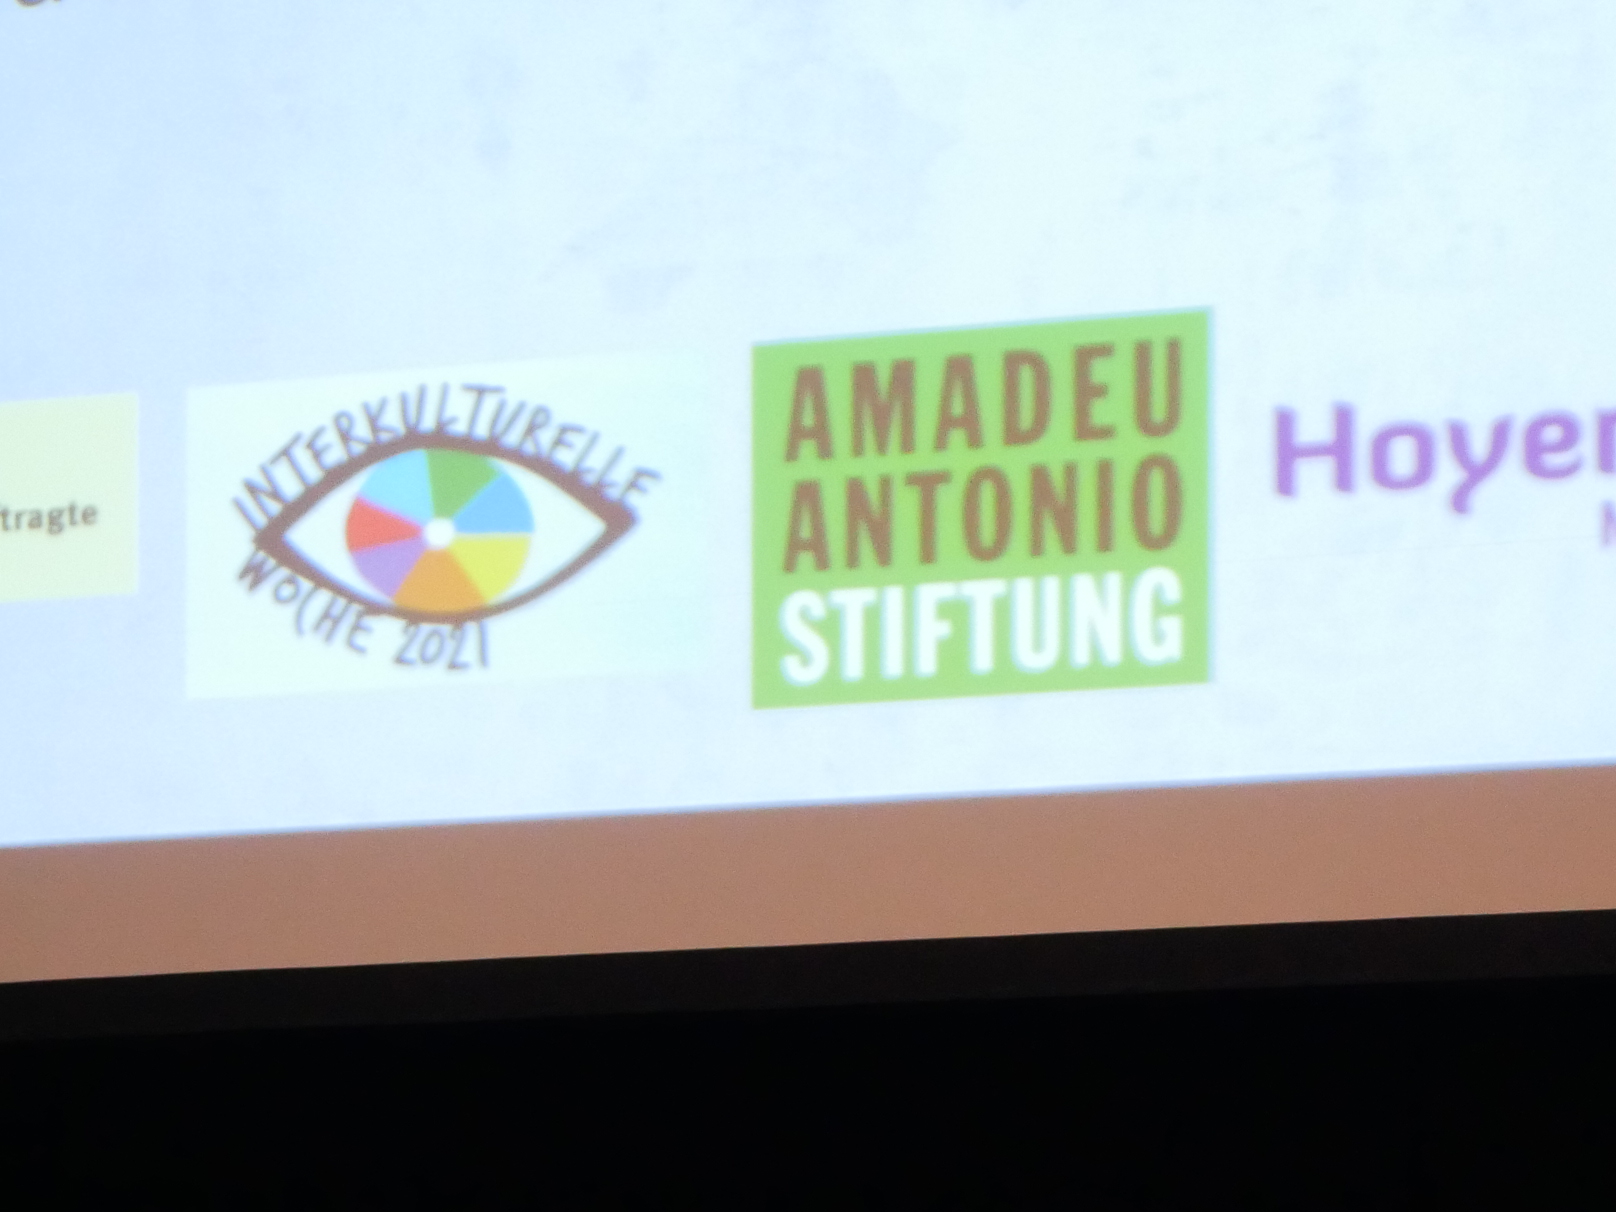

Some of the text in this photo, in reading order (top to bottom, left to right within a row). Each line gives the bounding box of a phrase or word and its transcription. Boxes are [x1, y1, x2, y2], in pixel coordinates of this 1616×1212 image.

[233, 382, 663, 533] INTERKULTURELLE
[784, 336, 1183, 463] AMADEU
[782, 453, 1184, 574] ANTONIO
[237, 548, 490, 671] WOCHE 2021
[778, 565, 1184, 687] STIFTUNG
